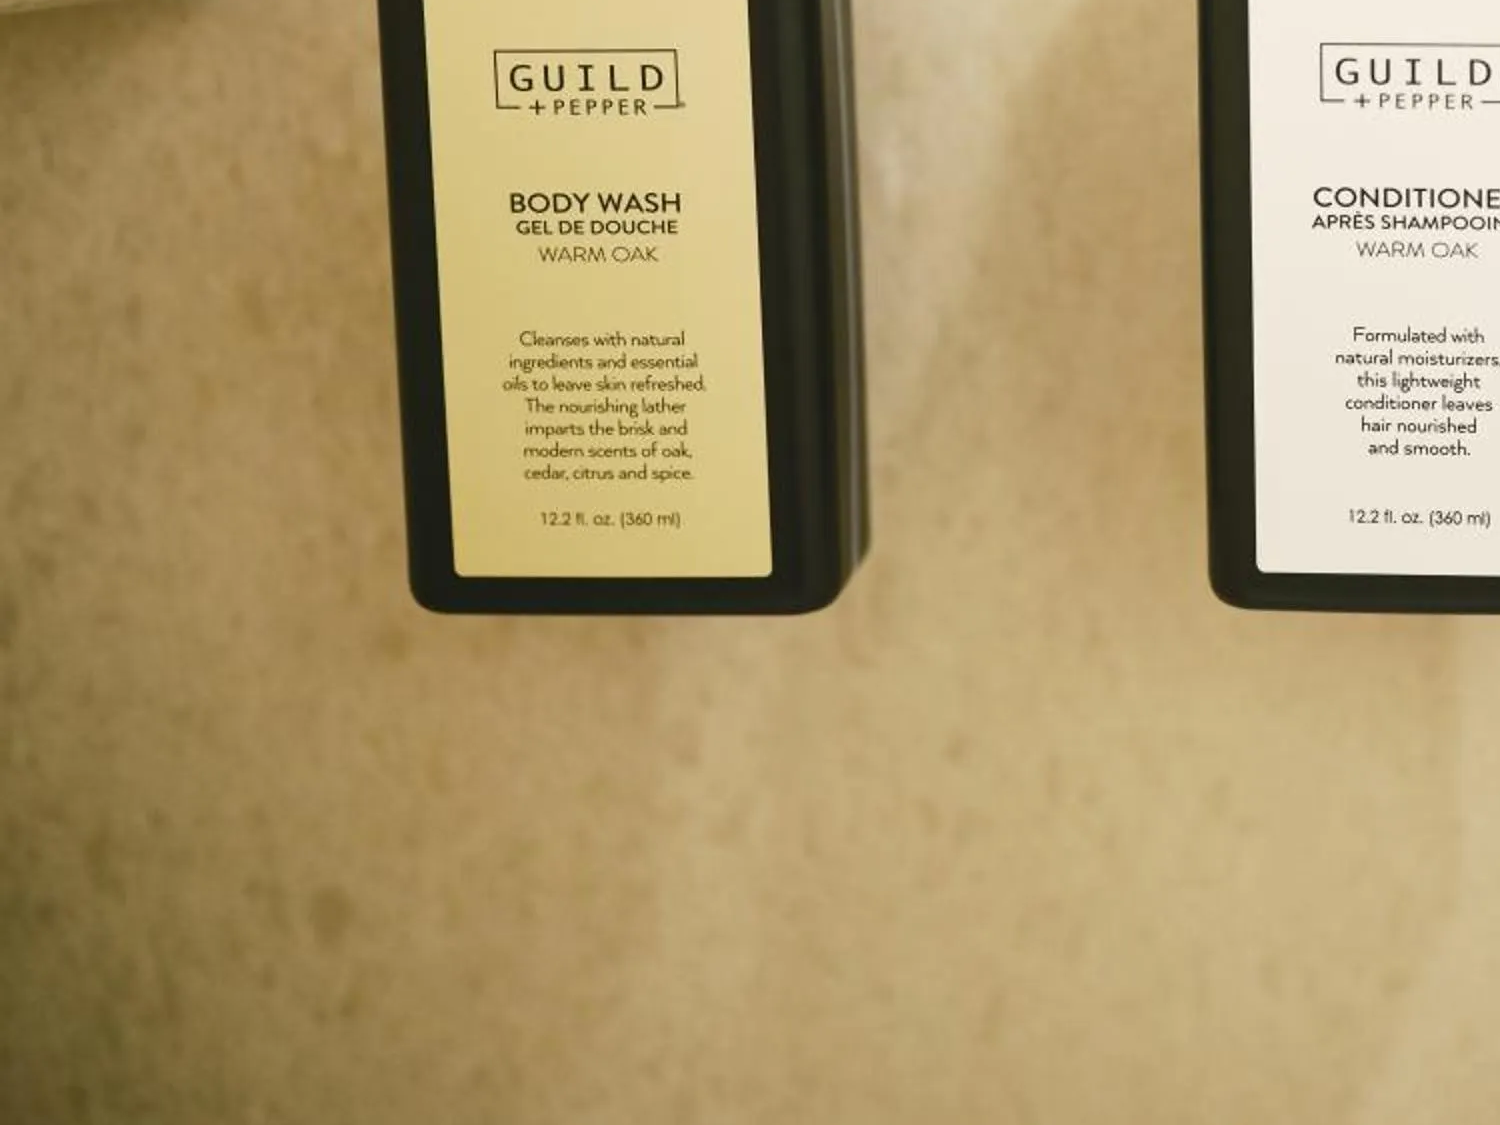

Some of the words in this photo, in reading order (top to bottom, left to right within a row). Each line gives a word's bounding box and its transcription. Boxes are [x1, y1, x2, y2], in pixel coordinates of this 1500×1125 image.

[508, 63, 664, 92] GUILD
[1334, 57, 1493, 86] GUILD
[509, 192, 591, 214] BODY
[597, 192, 683, 214] WASH
[515, 219, 553, 236] GEL
[558, 219, 585, 236] DE
[590, 219, 679, 236] DOUCHE
[1311, 210, 1376, 230] APRÈS
[537, 245, 608, 264] WARM
[610, 245, 660, 264] OAK
[1355, 240, 1426, 259] WARM
[1430, 241, 1480, 260] OAK
[518, 330, 590, 348] Cleanses
[593, 331, 627, 347] with
[630, 330, 686, 347] natural
[1352, 325, 1447, 344] Formulated
[1450, 326, 1486, 344] with
[508, 353, 594, 374] ingredients
[596, 353, 627, 370] and
[630, 352, 699, 370] essential
[1334, 348, 1394, 366] natural
[502, 375, 529, 392] oils
[533, 378, 549, 392] to
[551, 375, 593, 392] leave
[595, 375, 627, 392] skin
[630, 374, 708, 393] refreshed.
[1356, 371, 1388, 389] this
[1391, 371, 1482, 394] lightweight
[524, 398, 556, 415] The
[558, 397, 639, 418] nourishing
[641, 397, 687, 414] lather
[1344, 394, 1438, 411] conditioner
[1440, 394, 1494, 413] leaves
[524, 420, 586, 440] imparts
[588, 419, 615, 436] the
[617, 419, 655, 436] brisk
[658, 419, 688, 436] and
[1360, 416, 1393, 433] hair
[1396, 417, 1478, 434] nourished
[522, 442, 585, 459] modern
[587, 445, 638, 459] scents
[640, 442, 659, 459] of
[661, 442, 693, 460] oak,
[1367, 439, 1399, 456] and
[1403, 439, 1472, 457] smooth.
[523, 463, 570, 482] cedar,
[572, 465, 615, 481] citrus
[617, 463, 648, 481] and
[540, 511, 572, 527] 12.2
[575, 511, 589, 527] fl.
[592, 514, 616, 527] oz.
[620, 511, 654, 530] (360
[656, 511, 682, 529] ml)
[1348, 508, 1380, 525] 12.2
[1383, 508, 1398, 525] fl.
[1401, 511, 1424, 525] oz.
[1428, 510, 1463, 528] (360
[1466, 510, 1492, 529] ml)
